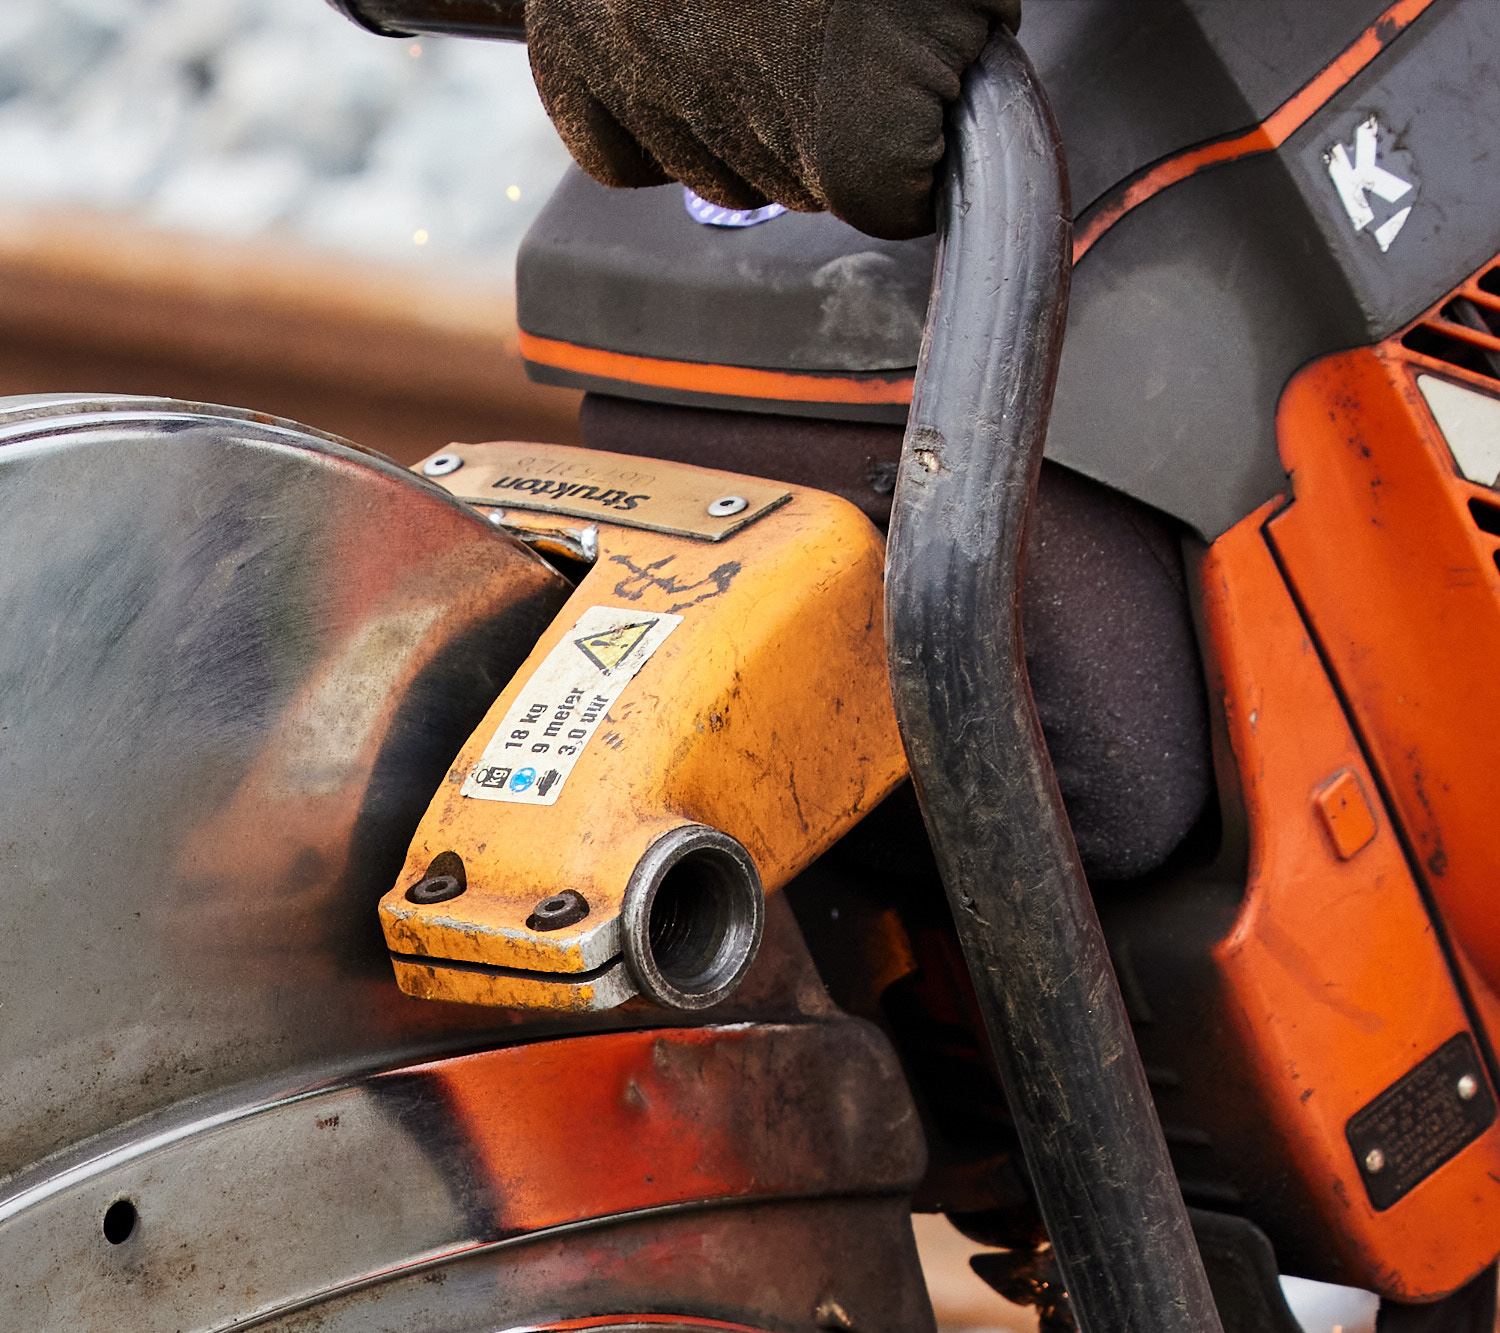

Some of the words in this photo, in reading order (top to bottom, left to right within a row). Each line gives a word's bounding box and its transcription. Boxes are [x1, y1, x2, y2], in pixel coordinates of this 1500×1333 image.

[1323, 114, 1413, 252] K
[492, 475, 652, 511] Strukton
[504, 728, 530, 751] 18
[519, 702, 549, 724] kg
[530, 742, 551, 754] 9
[543, 686, 586, 737] meter
[579, 693, 610, 724] uur
